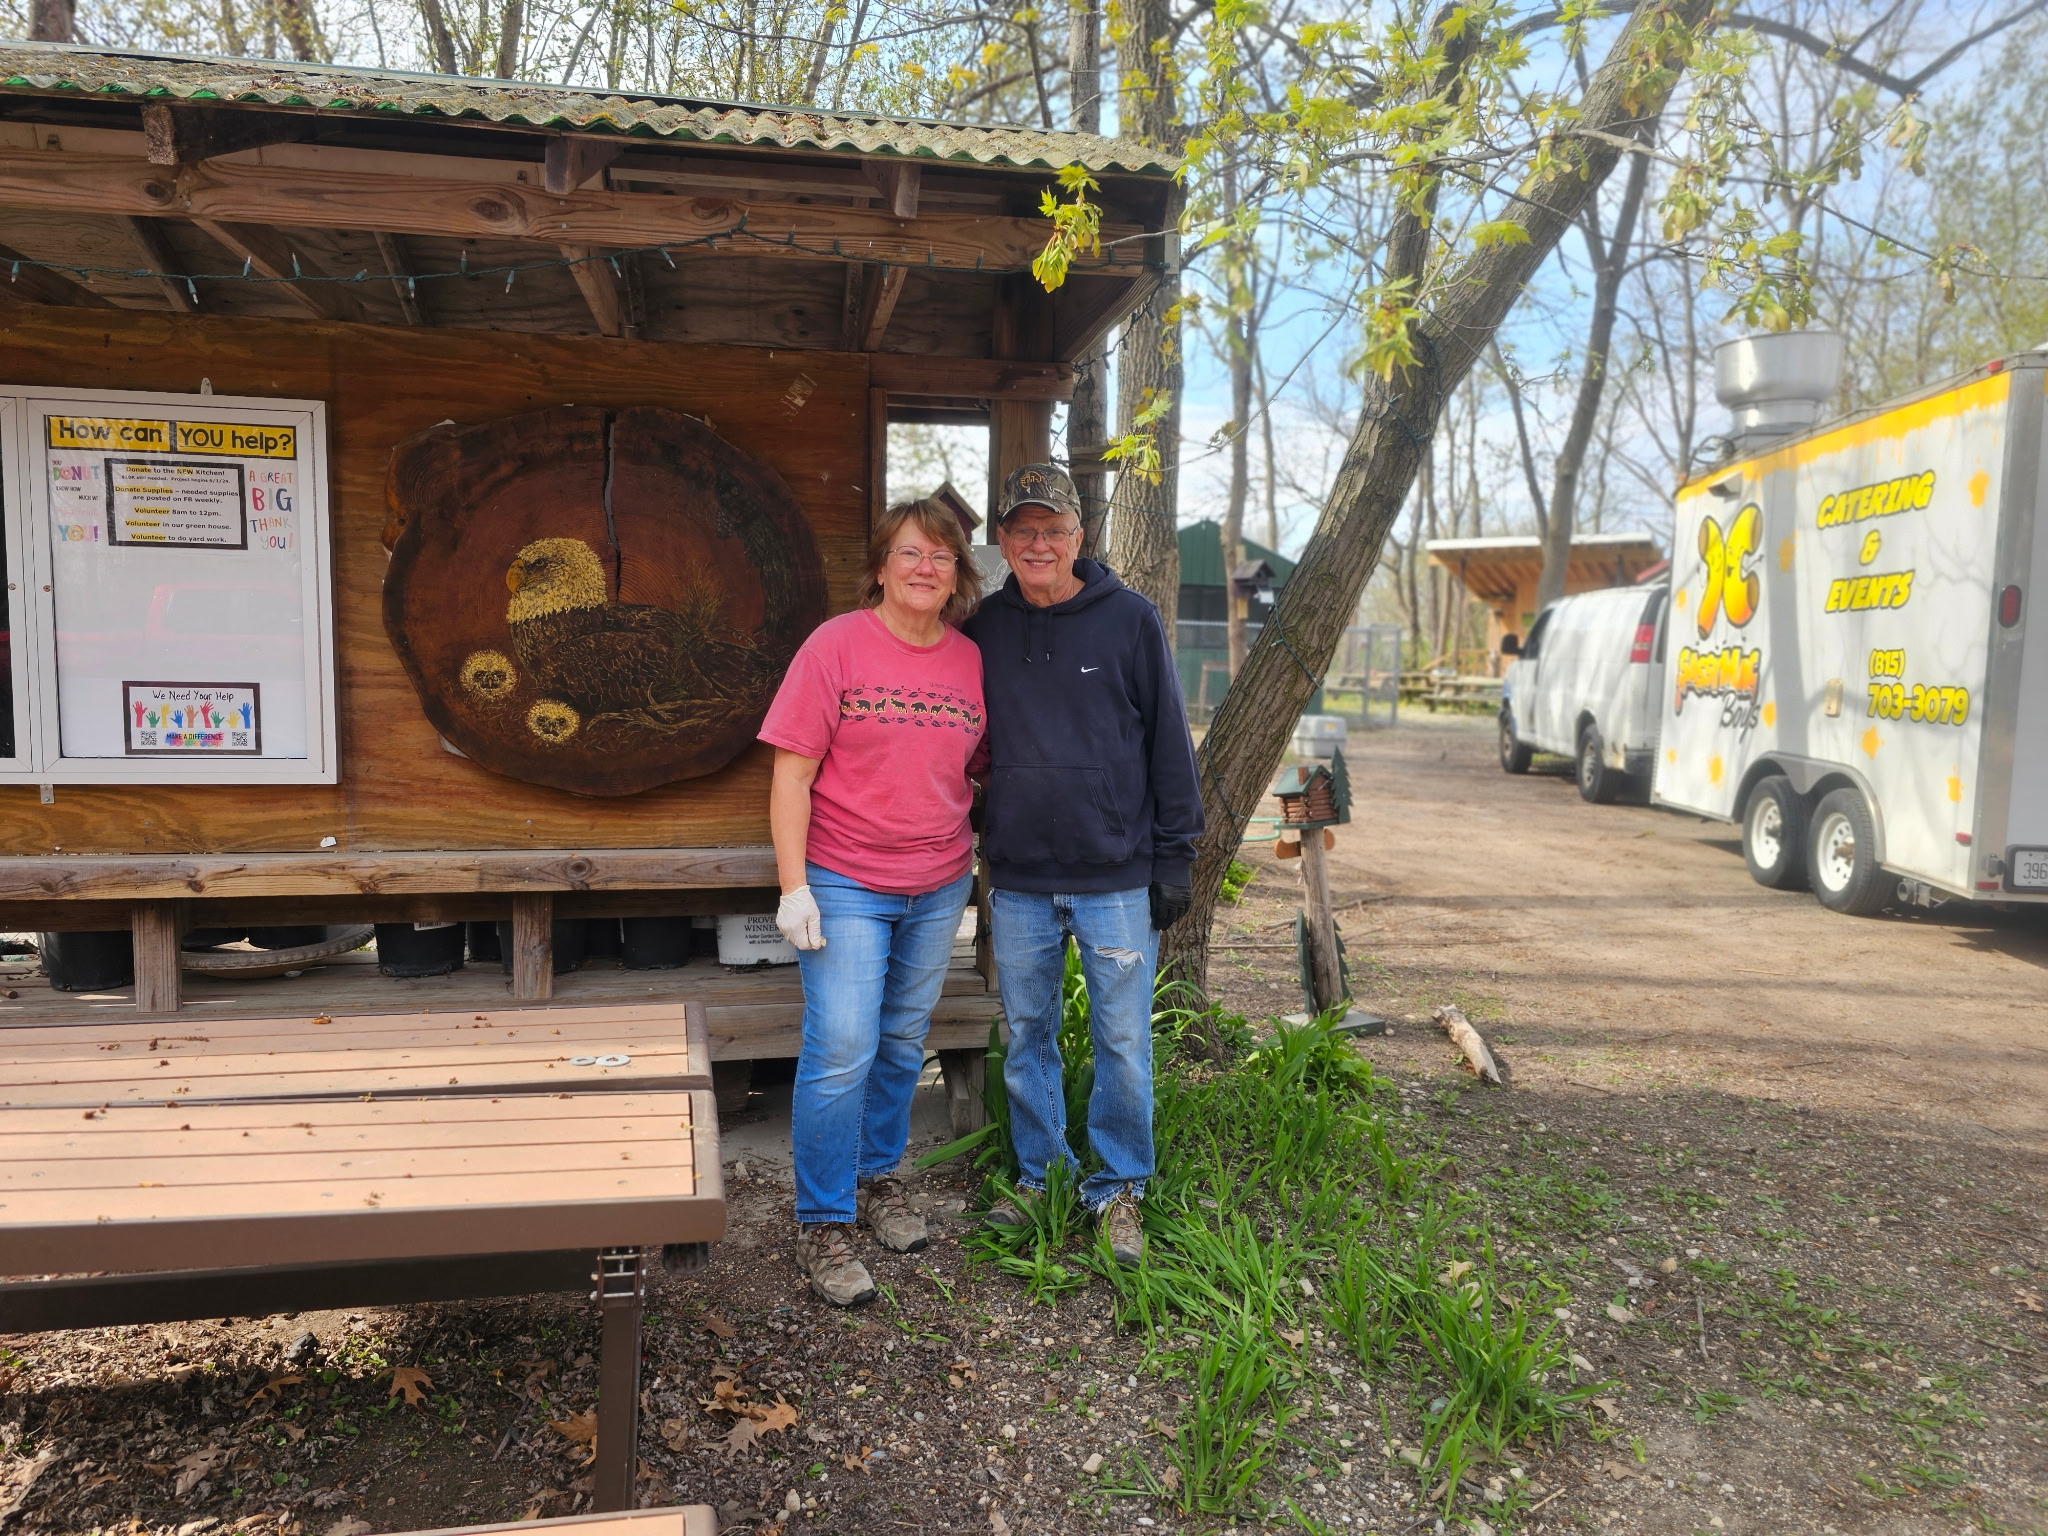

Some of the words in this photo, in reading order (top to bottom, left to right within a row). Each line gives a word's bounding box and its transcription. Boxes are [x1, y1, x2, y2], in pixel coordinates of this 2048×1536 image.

[59, 419, 111, 440] How
[120, 426, 163, 443] can
[179, 427, 224, 448] YOU
[231, 430, 292, 454] help?
[53, 465, 100, 481] DONUT
[249, 470, 256, 482] A
[260, 471, 294, 484] GREAT
[194, 497, 223, 505] weekly.
[251, 487, 293, 512] BIG
[1816, 468, 1936, 531] CATERING
[134, 507, 170, 515] Volunteer
[125, 520, 161, 528] Volunteer
[249, 517, 293, 533] THANK
[57, 524, 99, 543] YOU!
[131, 533, 167, 541] Volunteer
[1859, 528, 1882, 567] &
[1824, 568, 1916, 614] EVENTS
[1868, 647, 1906, 680] (815)
[152, 689, 166, 700] We
[169, 690, 191, 701] Need
[194, 690, 212, 701] Your
[215, 691, 234, 703] Help
[1866, 682, 1971, 726] 703-3079
[1719, 690, 1761, 744] Boys
[188, 733, 224, 741] DIFFERENCE
[2023, 862, 2048, 880] 396
[744, 924, 780, 932] WINNER
[747, 916, 777, 924] PROVE
